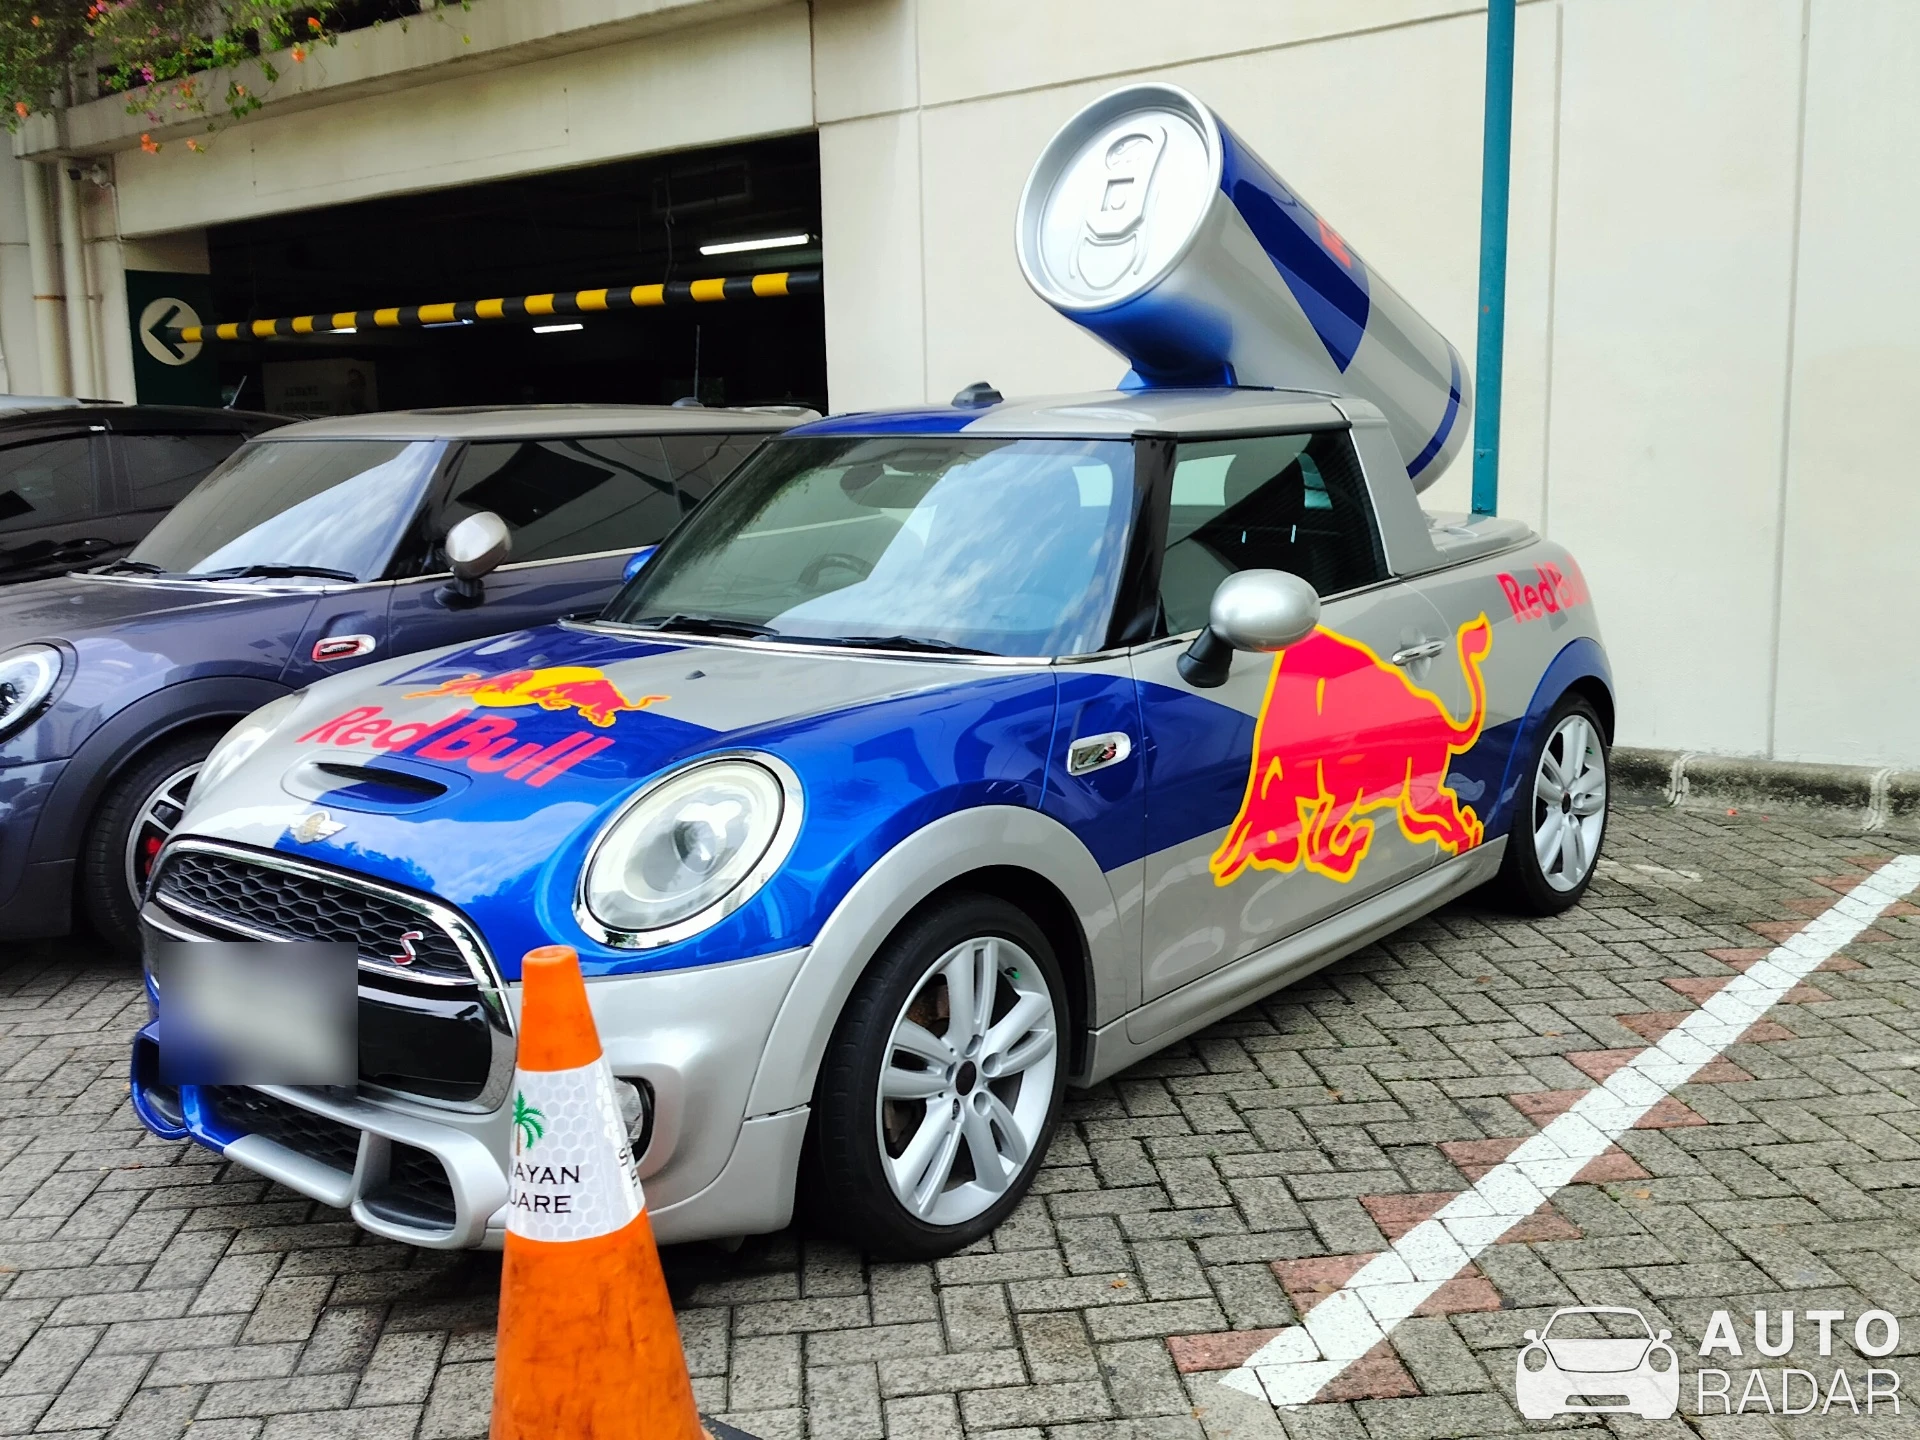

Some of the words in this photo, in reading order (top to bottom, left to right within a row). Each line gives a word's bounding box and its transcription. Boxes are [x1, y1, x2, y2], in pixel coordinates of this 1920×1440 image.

[1496, 561, 1560, 624] Red
[295, 706, 471, 752] Red
[414, 713, 616, 788] Bull
[390, 930, 424, 966] S
[511, 1161, 580, 1184] AYAN
